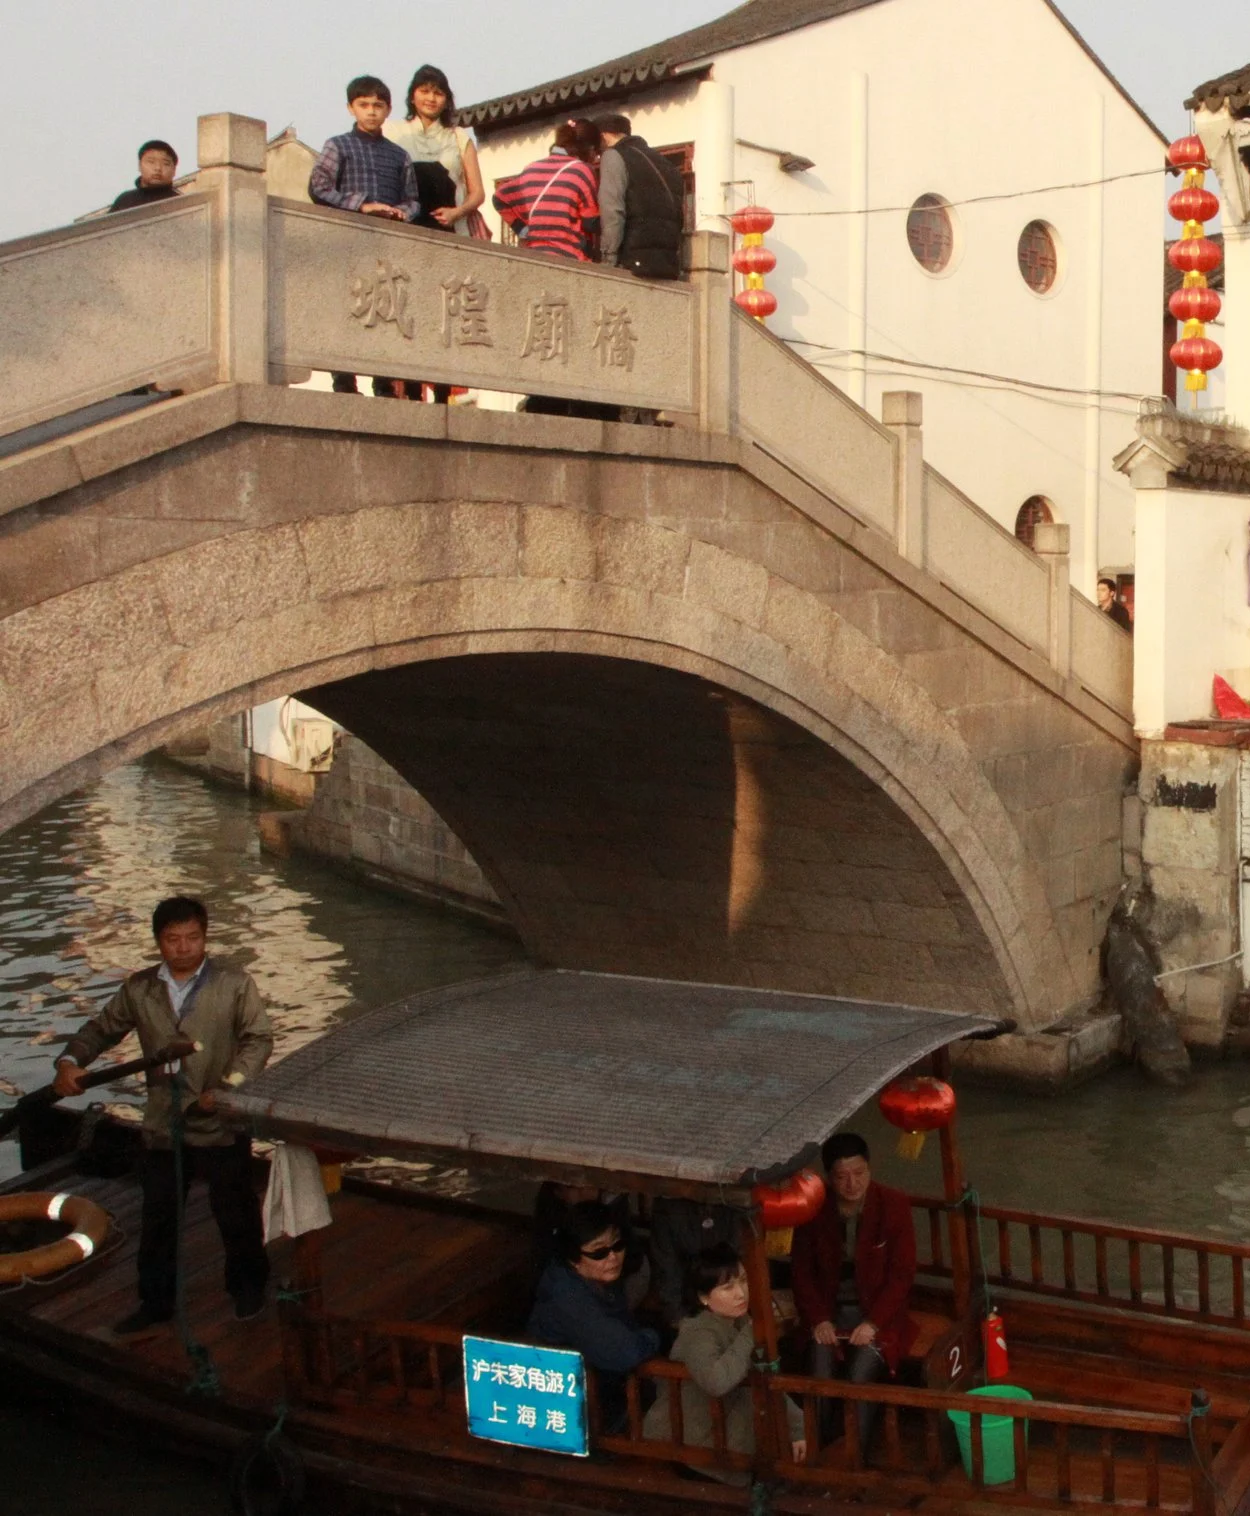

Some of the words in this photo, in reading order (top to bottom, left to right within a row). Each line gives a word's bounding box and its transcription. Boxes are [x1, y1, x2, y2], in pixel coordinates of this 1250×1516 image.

[351, 260, 639, 371] 城隍廟橋
[950, 1346, 962, 1377] 2
[488, 1400, 566, 1433] 上海港
